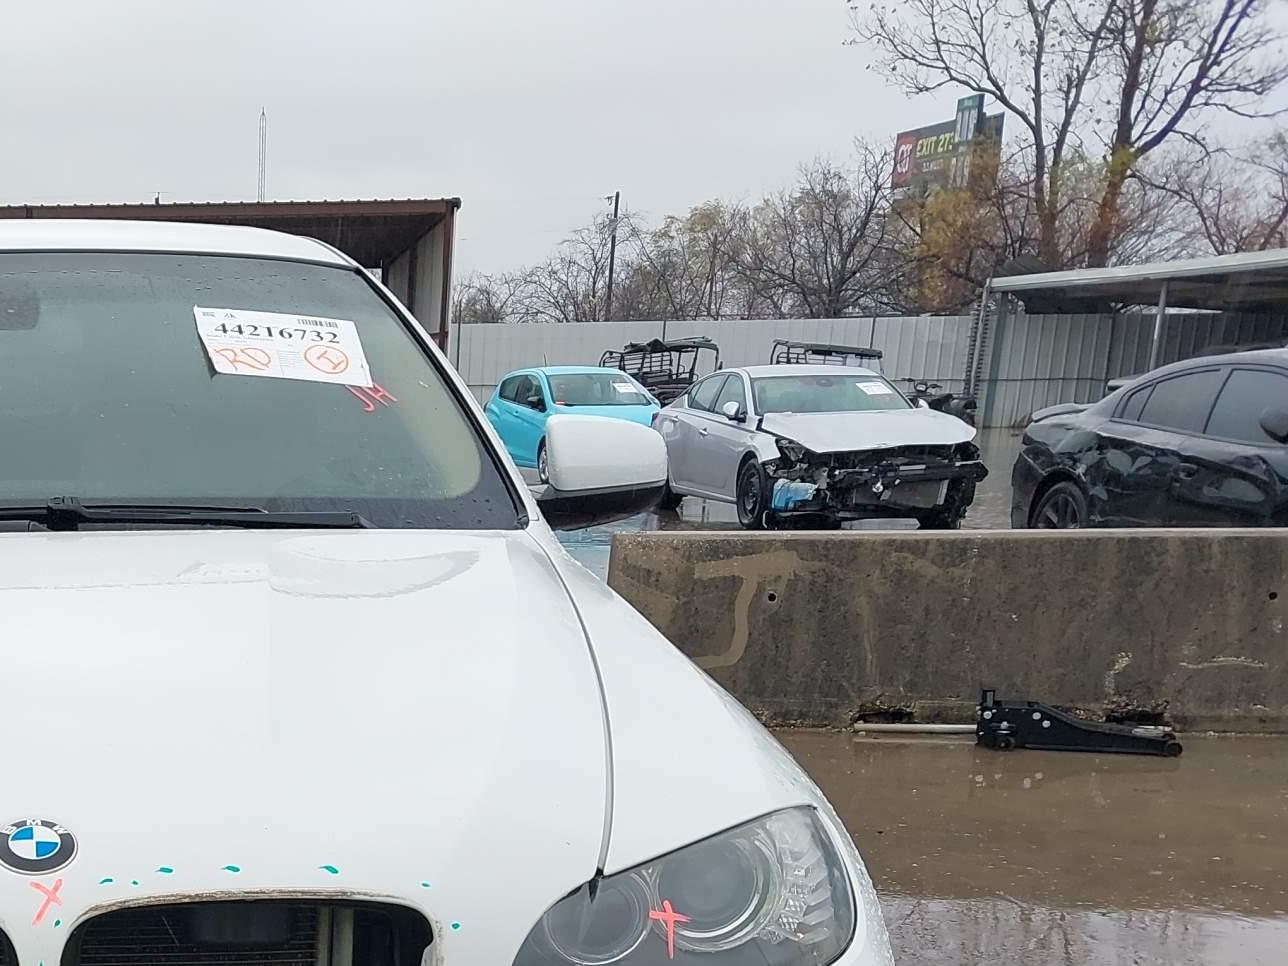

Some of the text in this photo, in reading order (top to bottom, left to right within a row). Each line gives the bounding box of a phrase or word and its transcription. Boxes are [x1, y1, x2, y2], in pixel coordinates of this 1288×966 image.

[915, 136, 937, 157] EXIT
[214, 322, 341, 344] 44216732
[1, 817, 70, 835] BMW
